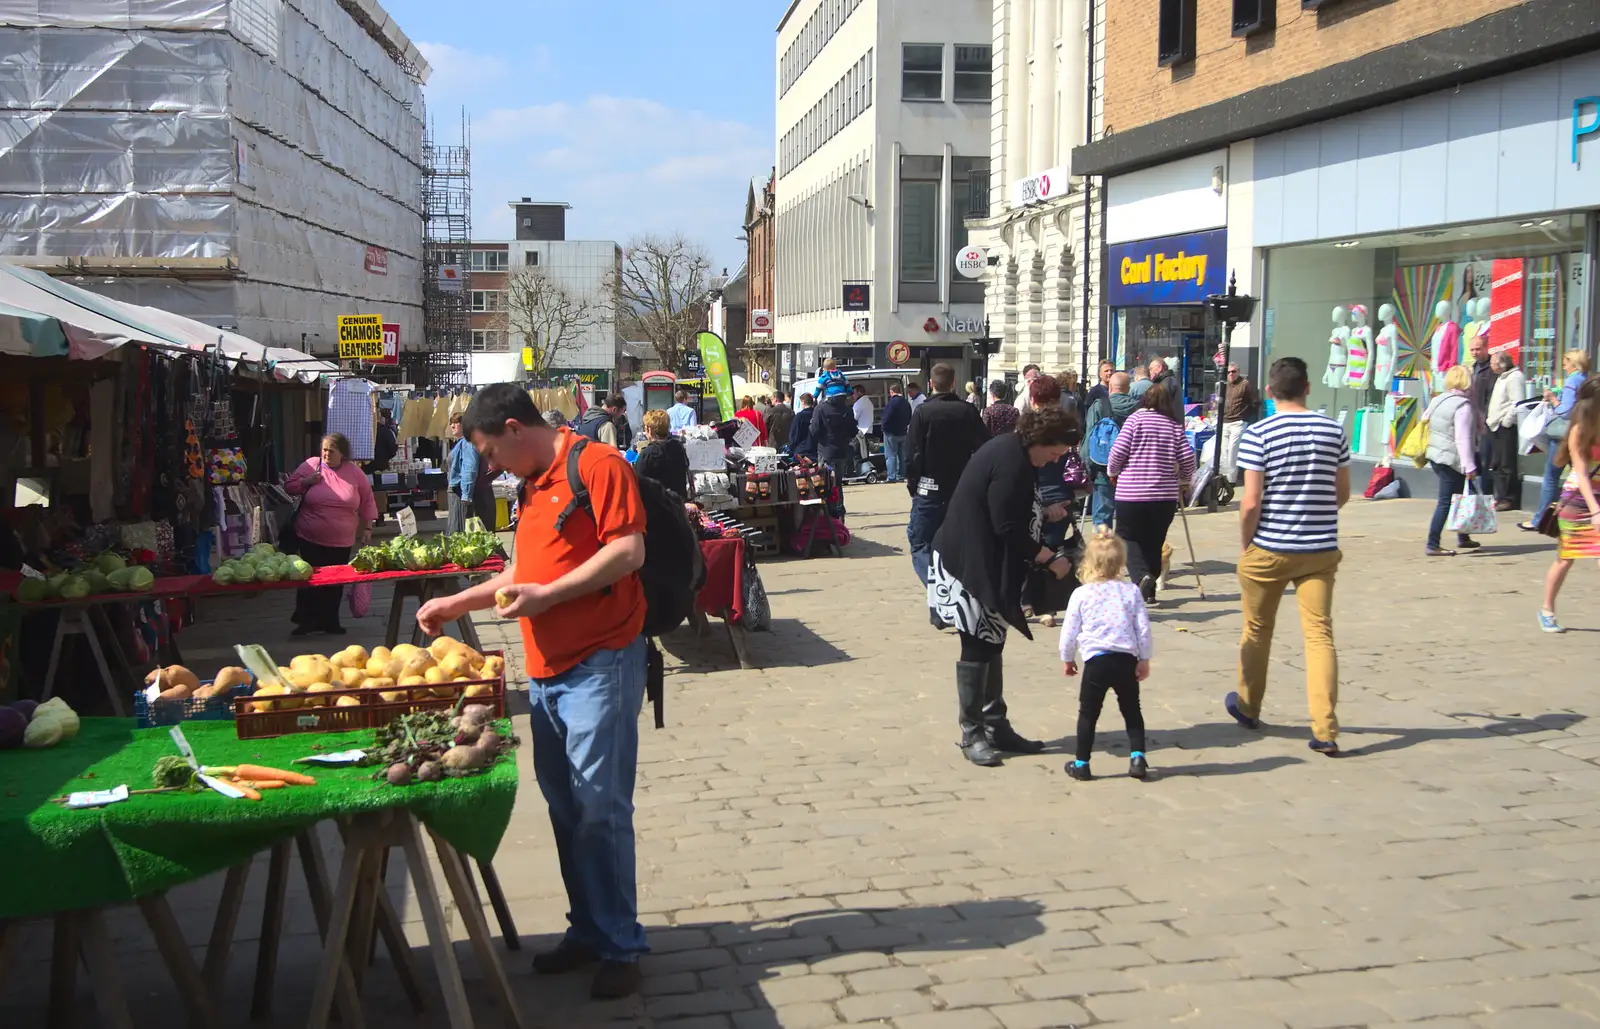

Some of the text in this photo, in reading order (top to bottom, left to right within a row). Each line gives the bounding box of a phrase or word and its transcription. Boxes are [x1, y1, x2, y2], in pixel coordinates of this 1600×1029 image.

[1022, 177, 1040, 201] HSBC
[960, 260, 986, 269] HSBC
[1121, 251, 1208, 286] Card Factory
[341, 325, 381, 340] CHAMOIS
[341, 342, 382, 356] LEATHERS
